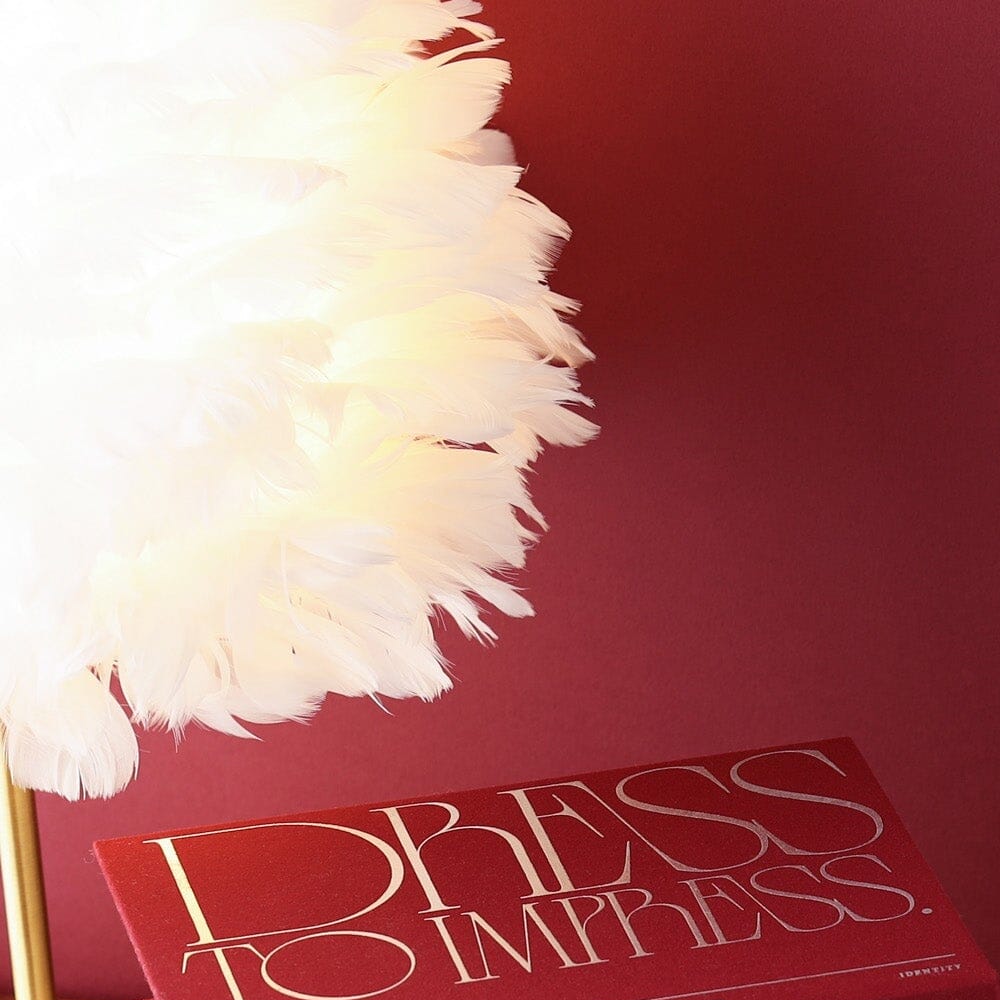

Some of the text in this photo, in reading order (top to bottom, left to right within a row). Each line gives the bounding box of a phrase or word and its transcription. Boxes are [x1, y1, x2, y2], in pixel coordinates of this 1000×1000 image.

[143, 749, 886, 946] DRESS
[424, 854, 933, 986] IMPRESS.
[898, 963, 962, 979] IDENTITY
